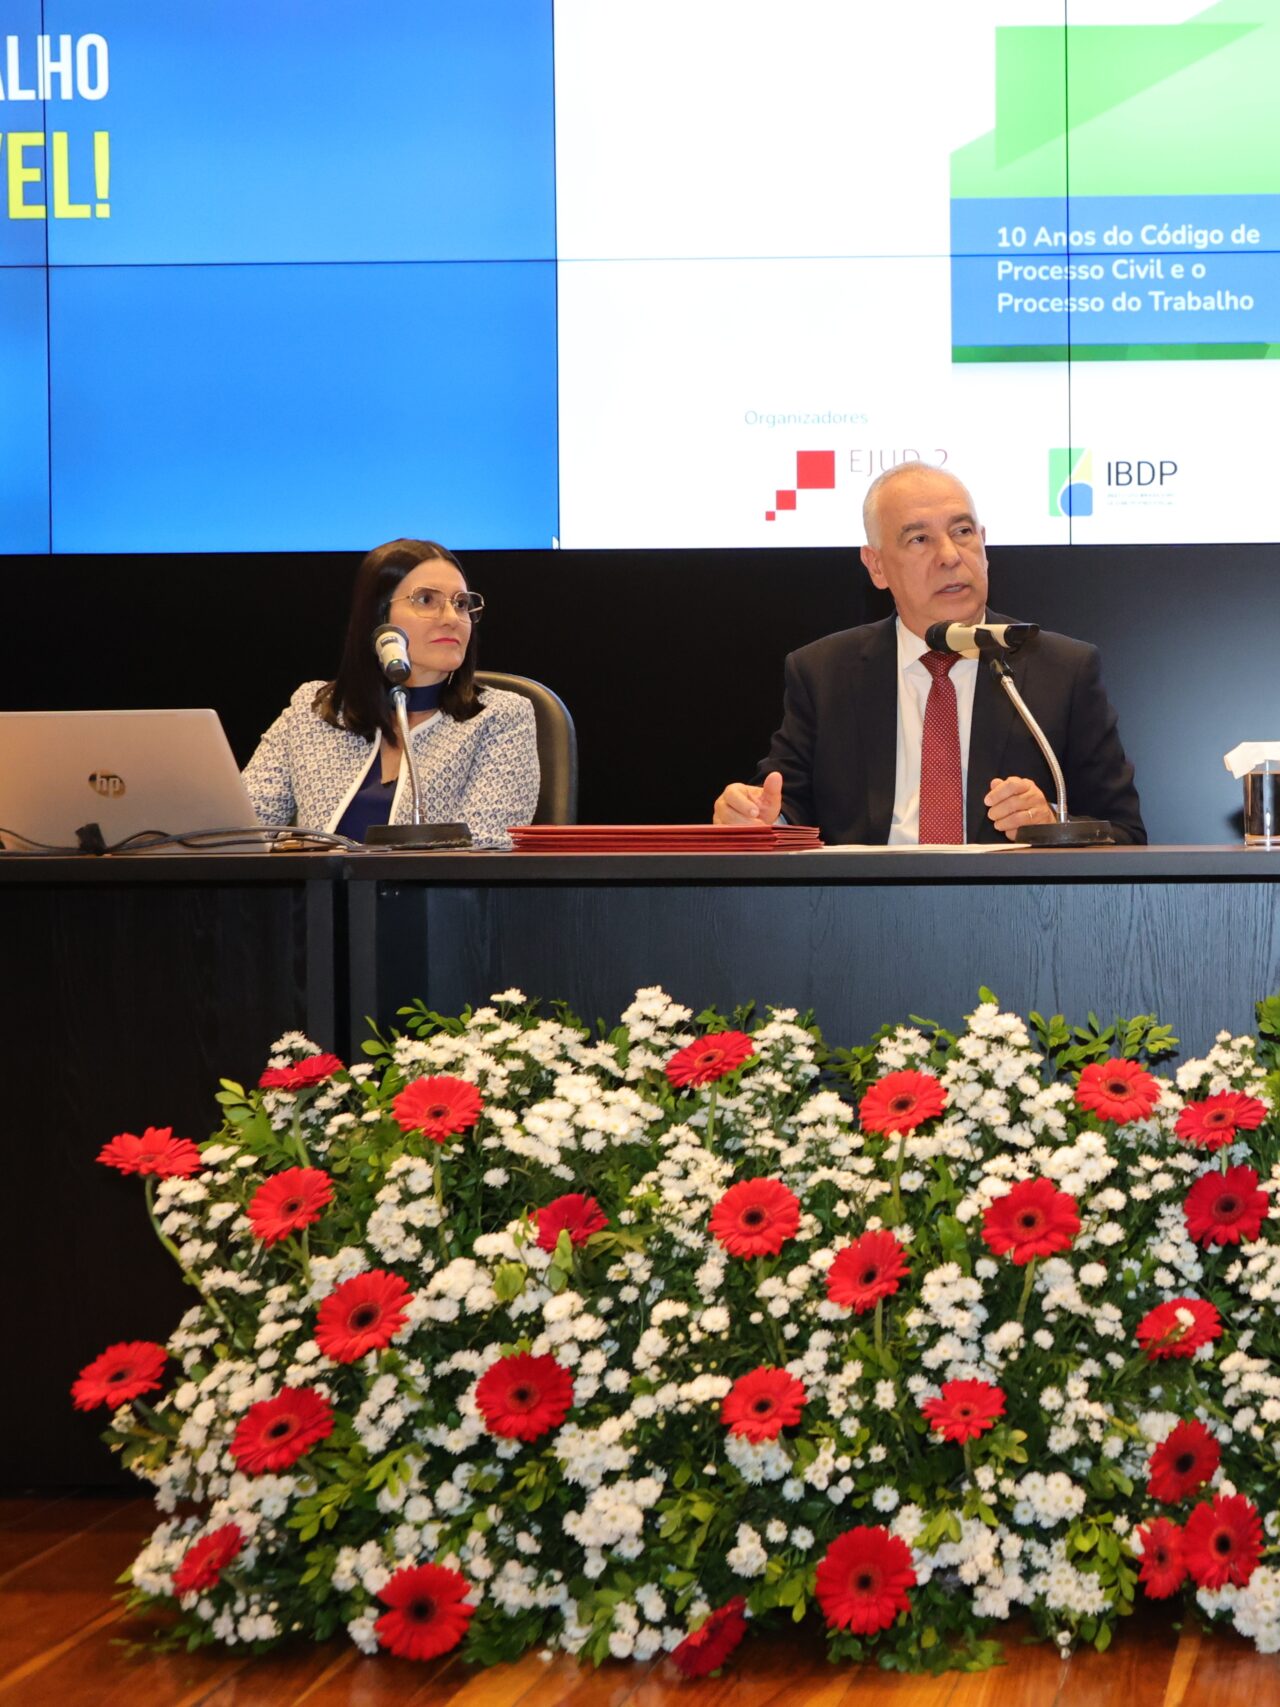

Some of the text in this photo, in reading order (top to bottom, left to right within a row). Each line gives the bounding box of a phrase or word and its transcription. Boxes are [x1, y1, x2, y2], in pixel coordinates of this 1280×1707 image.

[0, 33, 110, 101] LHO
[0, 131, 111, 220] EL!
[997, 223, 1261, 249] 10 Anos do Código de
[997, 258, 1207, 281] Processo Civil e o
[997, 290, 1255, 313] Processo do Trabalho
[744, 410, 869, 428] Organizadores
[1107, 461, 1178, 486] IBDP
